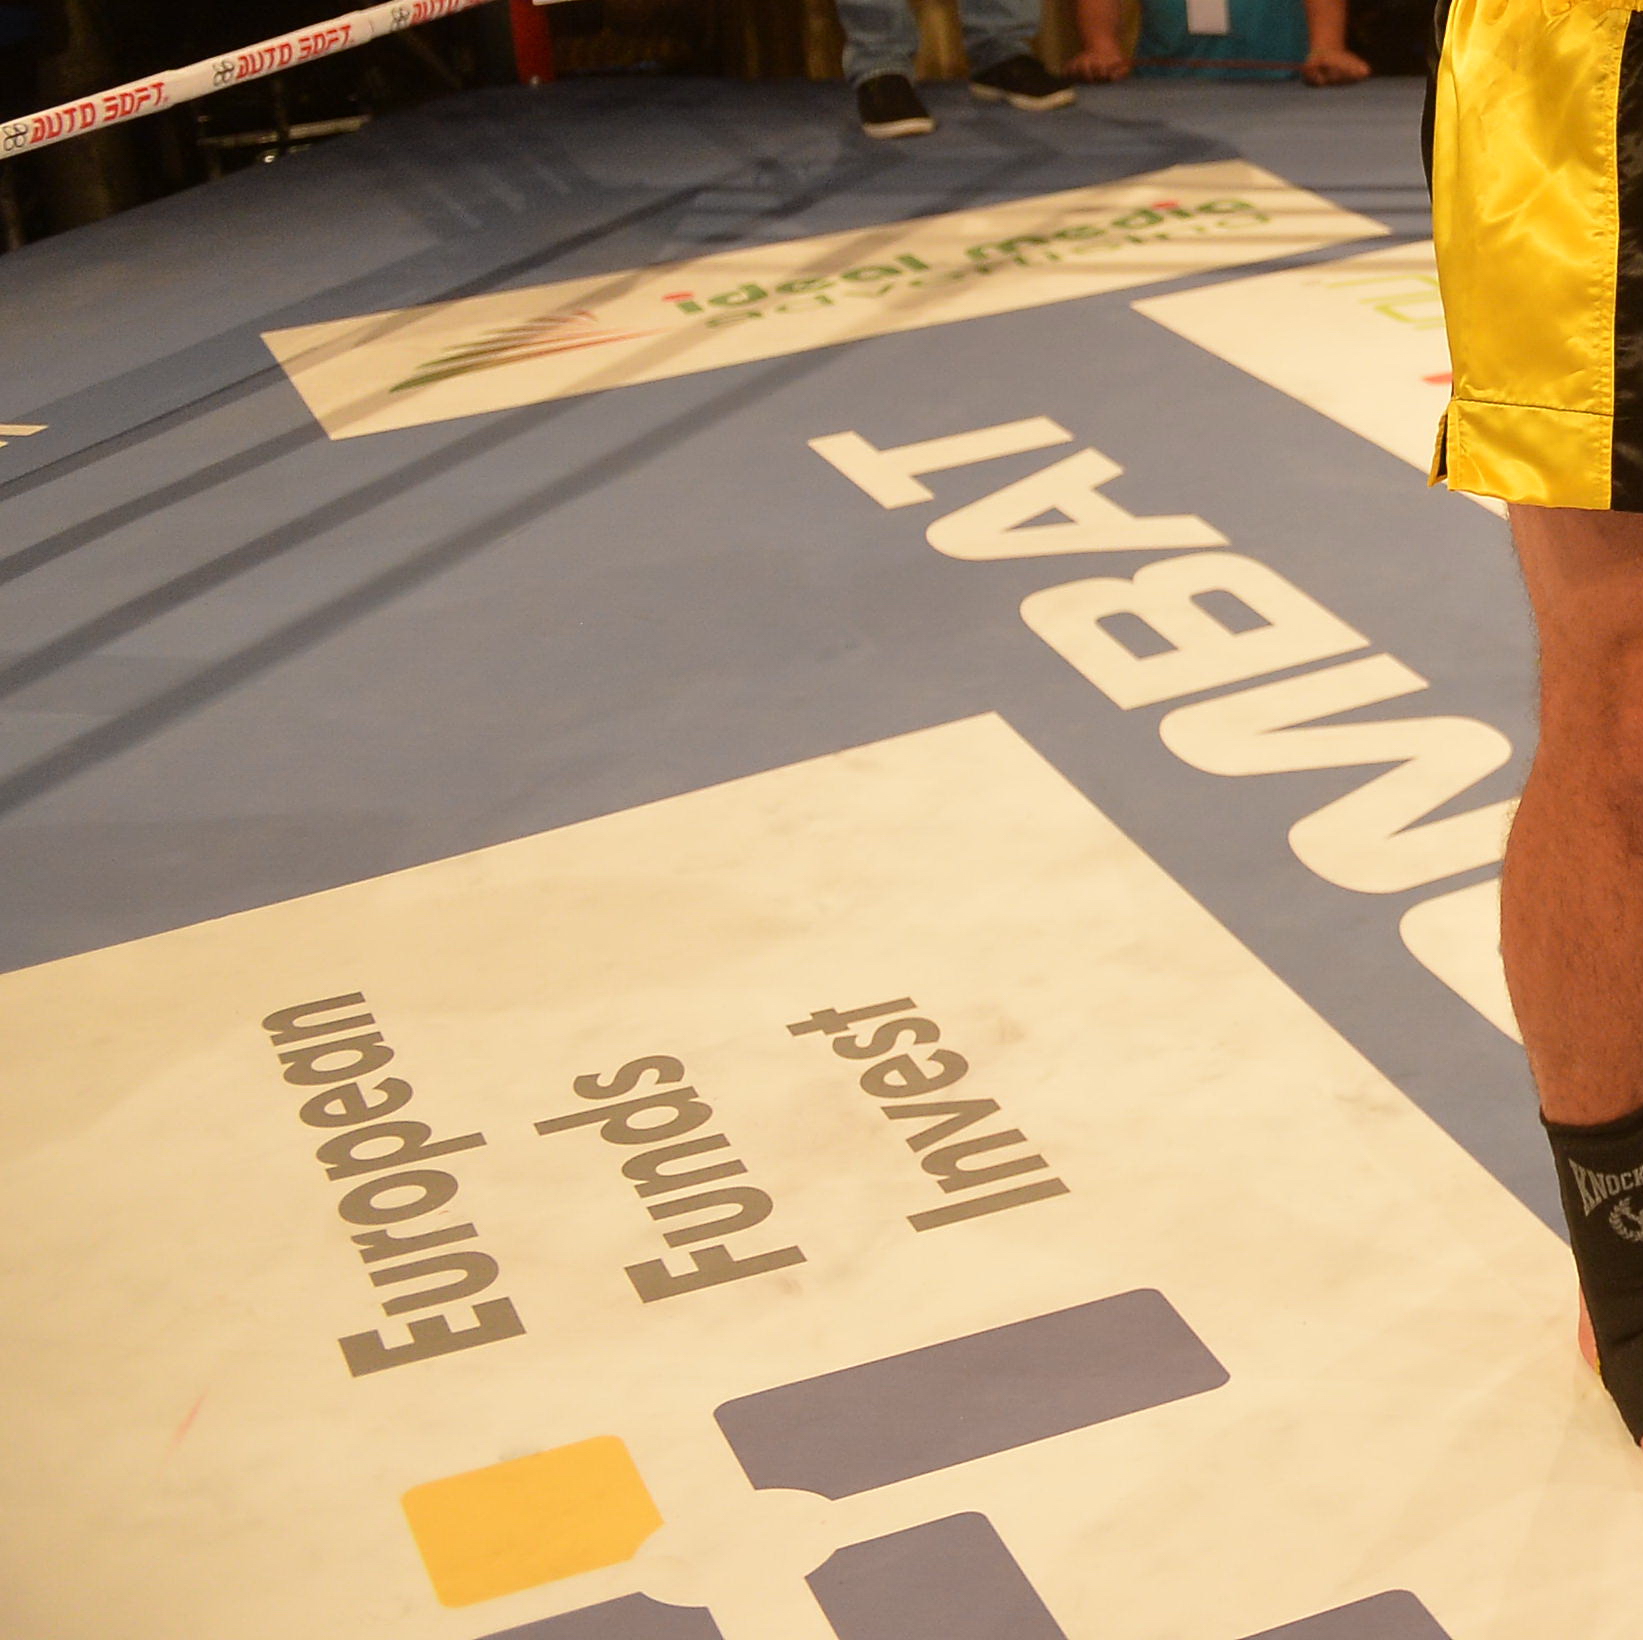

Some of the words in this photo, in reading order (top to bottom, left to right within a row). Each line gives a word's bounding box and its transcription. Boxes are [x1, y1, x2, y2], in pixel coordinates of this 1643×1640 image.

[30, 101, 95, 143] AUTO
[103, 82, 165, 120] SOFT
[236, 47, 293, 79] AUTO
[299, 25, 352, 58] SOFT
[662, 253, 930, 316] ideal
[261, 991, 527, 1379] European
[532, 1052, 808, 1304] Funds
[785, 996, 1071, 1233] Invest
